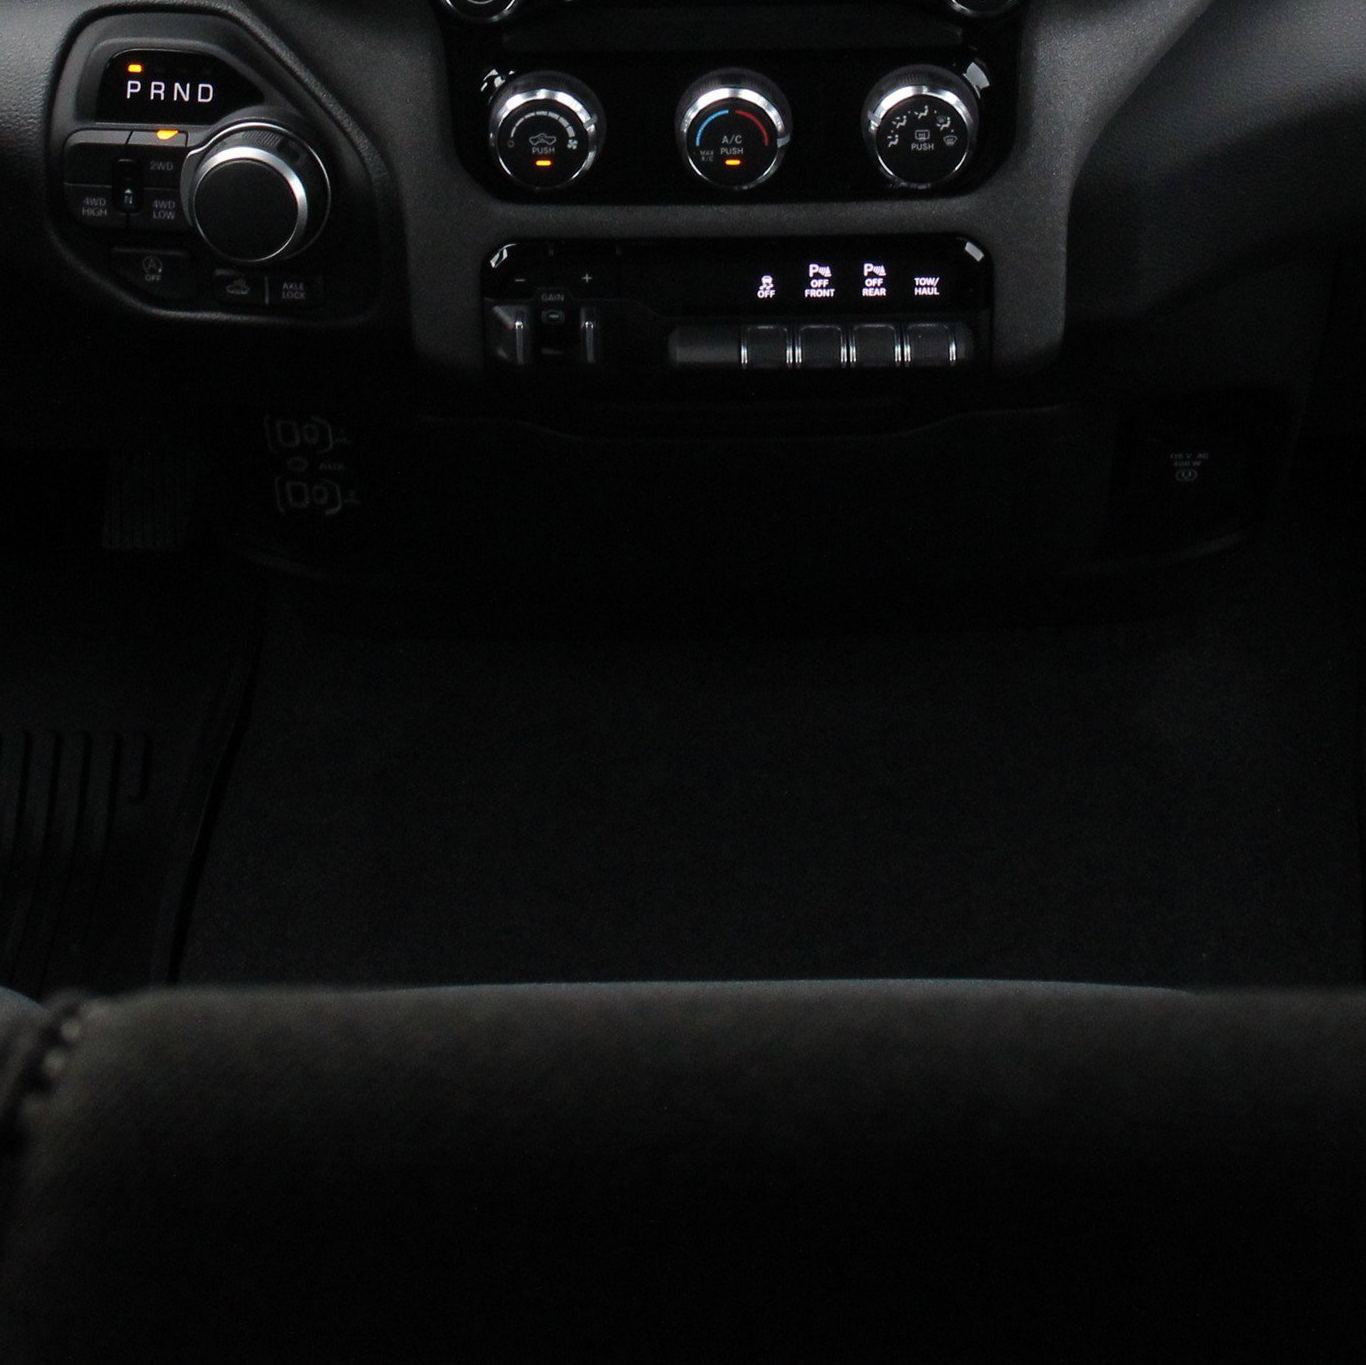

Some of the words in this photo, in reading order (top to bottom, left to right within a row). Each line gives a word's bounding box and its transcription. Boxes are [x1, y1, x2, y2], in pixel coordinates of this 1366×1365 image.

[722, 135, 742, 145] A/C
[531, 147, 555, 155] PUSH
[720, 147, 744, 155] PUSH
[910, 143, 935, 151] PUSH
[150, 161, 174, 172] 2WD
[84, 197, 106, 207] 4WD
[152, 200, 176, 210] 4WD
[82, 207, 108, 217] HIGH
[153, 210, 175, 220] LOW
[810, 279, 829, 288] OFF
[865, 278, 883, 287] OFF
[914, 276, 940, 286] TOW/
[757, 290, 775, 298] OFF
[805, 288, 835, 297] FRONT
[862, 287, 886, 297] REAR
[914, 287, 940, 296] HAUL
